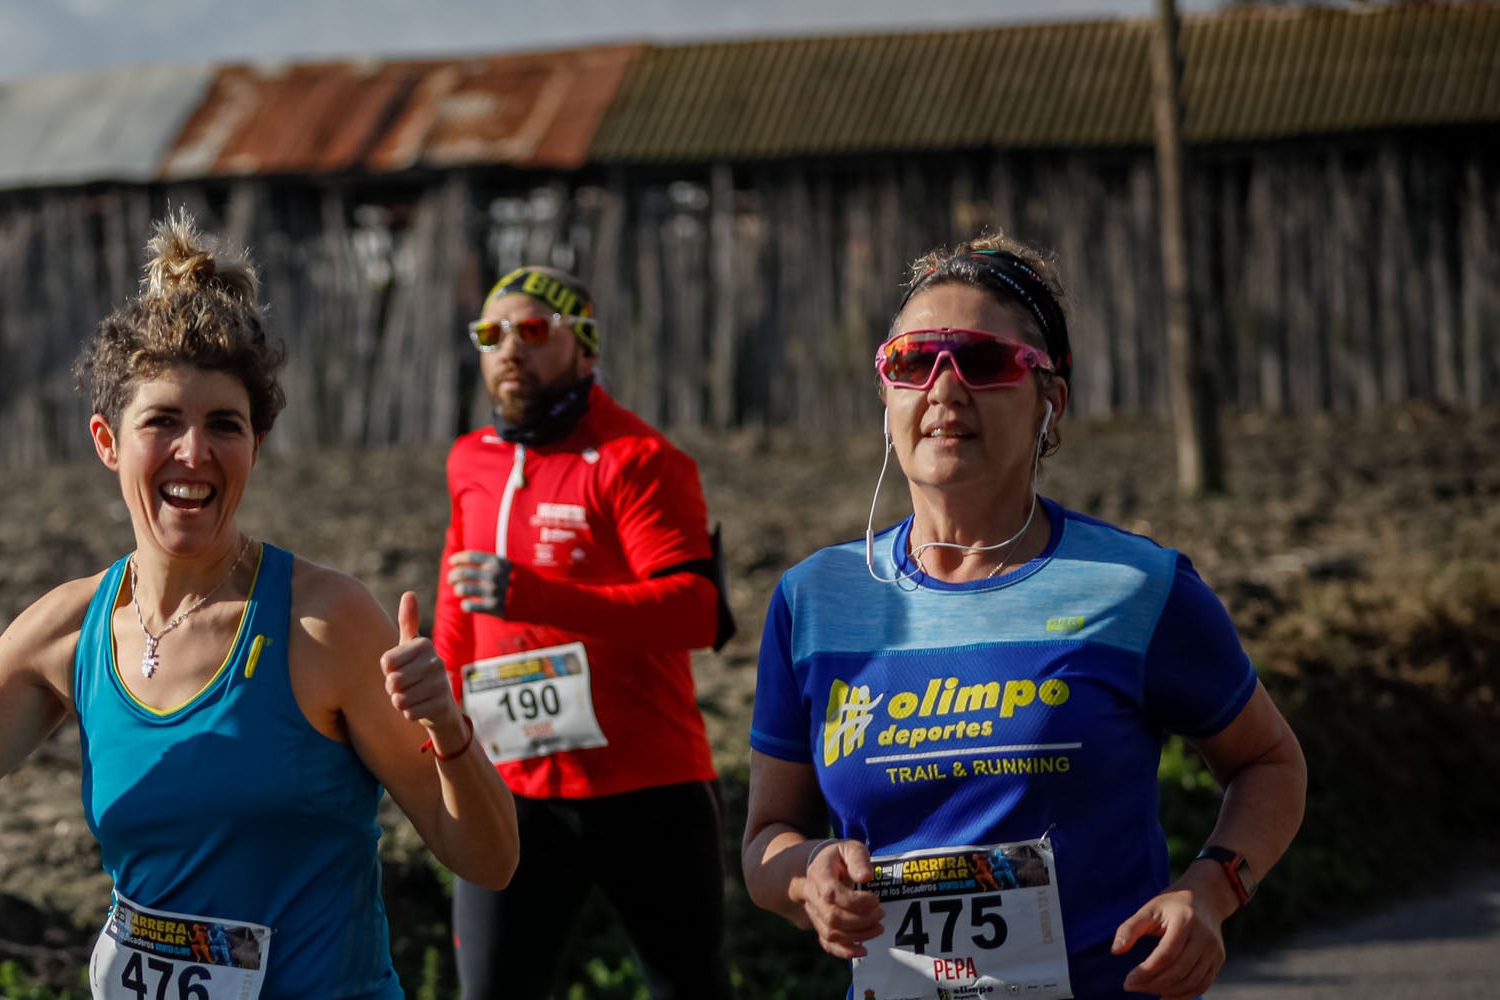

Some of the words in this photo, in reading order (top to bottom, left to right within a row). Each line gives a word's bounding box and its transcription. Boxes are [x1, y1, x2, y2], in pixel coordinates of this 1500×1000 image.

[499, 684, 561, 722] 190
[887, 677, 1070, 719] olimpo
[877, 719, 993, 748] deportes
[886, 764, 947, 785] TRAIL
[952, 762, 968, 777] &
[972, 756, 1071, 776] RUNNING
[903, 856, 968, 873] CARRERA
[903, 869, 969, 883] POPULAR
[889, 886, 900, 896] los
[902, 883, 937, 895] Secaderos
[895, 894, 1009, 956] 475
[934, 957, 978, 982] PEPA
[953, 985, 994, 995] olimpo
